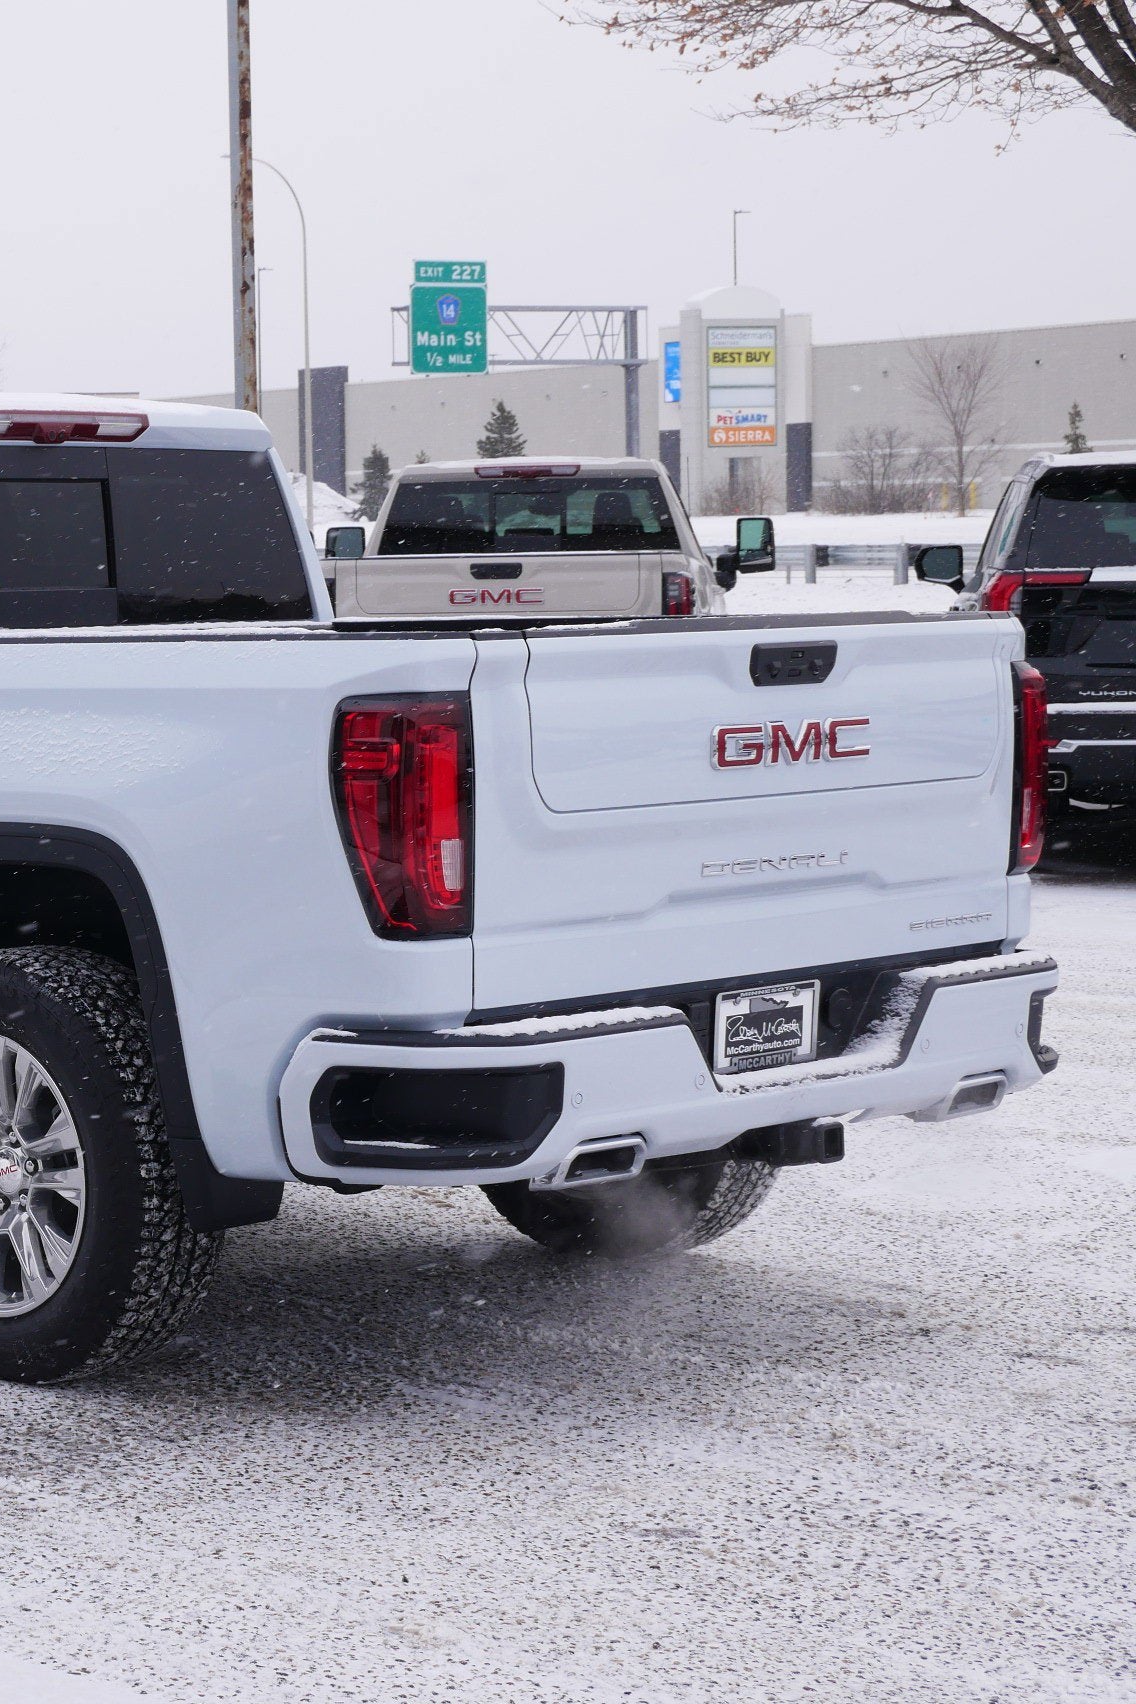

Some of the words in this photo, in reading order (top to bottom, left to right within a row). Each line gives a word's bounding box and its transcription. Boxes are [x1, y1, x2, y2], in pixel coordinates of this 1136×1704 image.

[420, 267, 443, 277] EXIT
[452, 265, 480, 280] 227
[442, 304, 455, 318] 14
[417, 331, 456, 346] Main
[465, 331, 482, 346] St
[449, 354, 472, 364] MILE
[713, 352, 742, 363] BEST
[745, 351, 771, 362] BUY
[728, 430, 771, 442] SIERRA
[448, 588, 544, 606] GMC
[710, 716, 871, 770] GMC
[701, 850, 849, 877] DENALI
[909, 912, 992, 931] SIERRA
[740, 985, 796, 998] MINNESOTA
[726, 1038, 801, 1055] McCarthyauto.com
[738, 1052, 793, 1070] MCCARTHY
